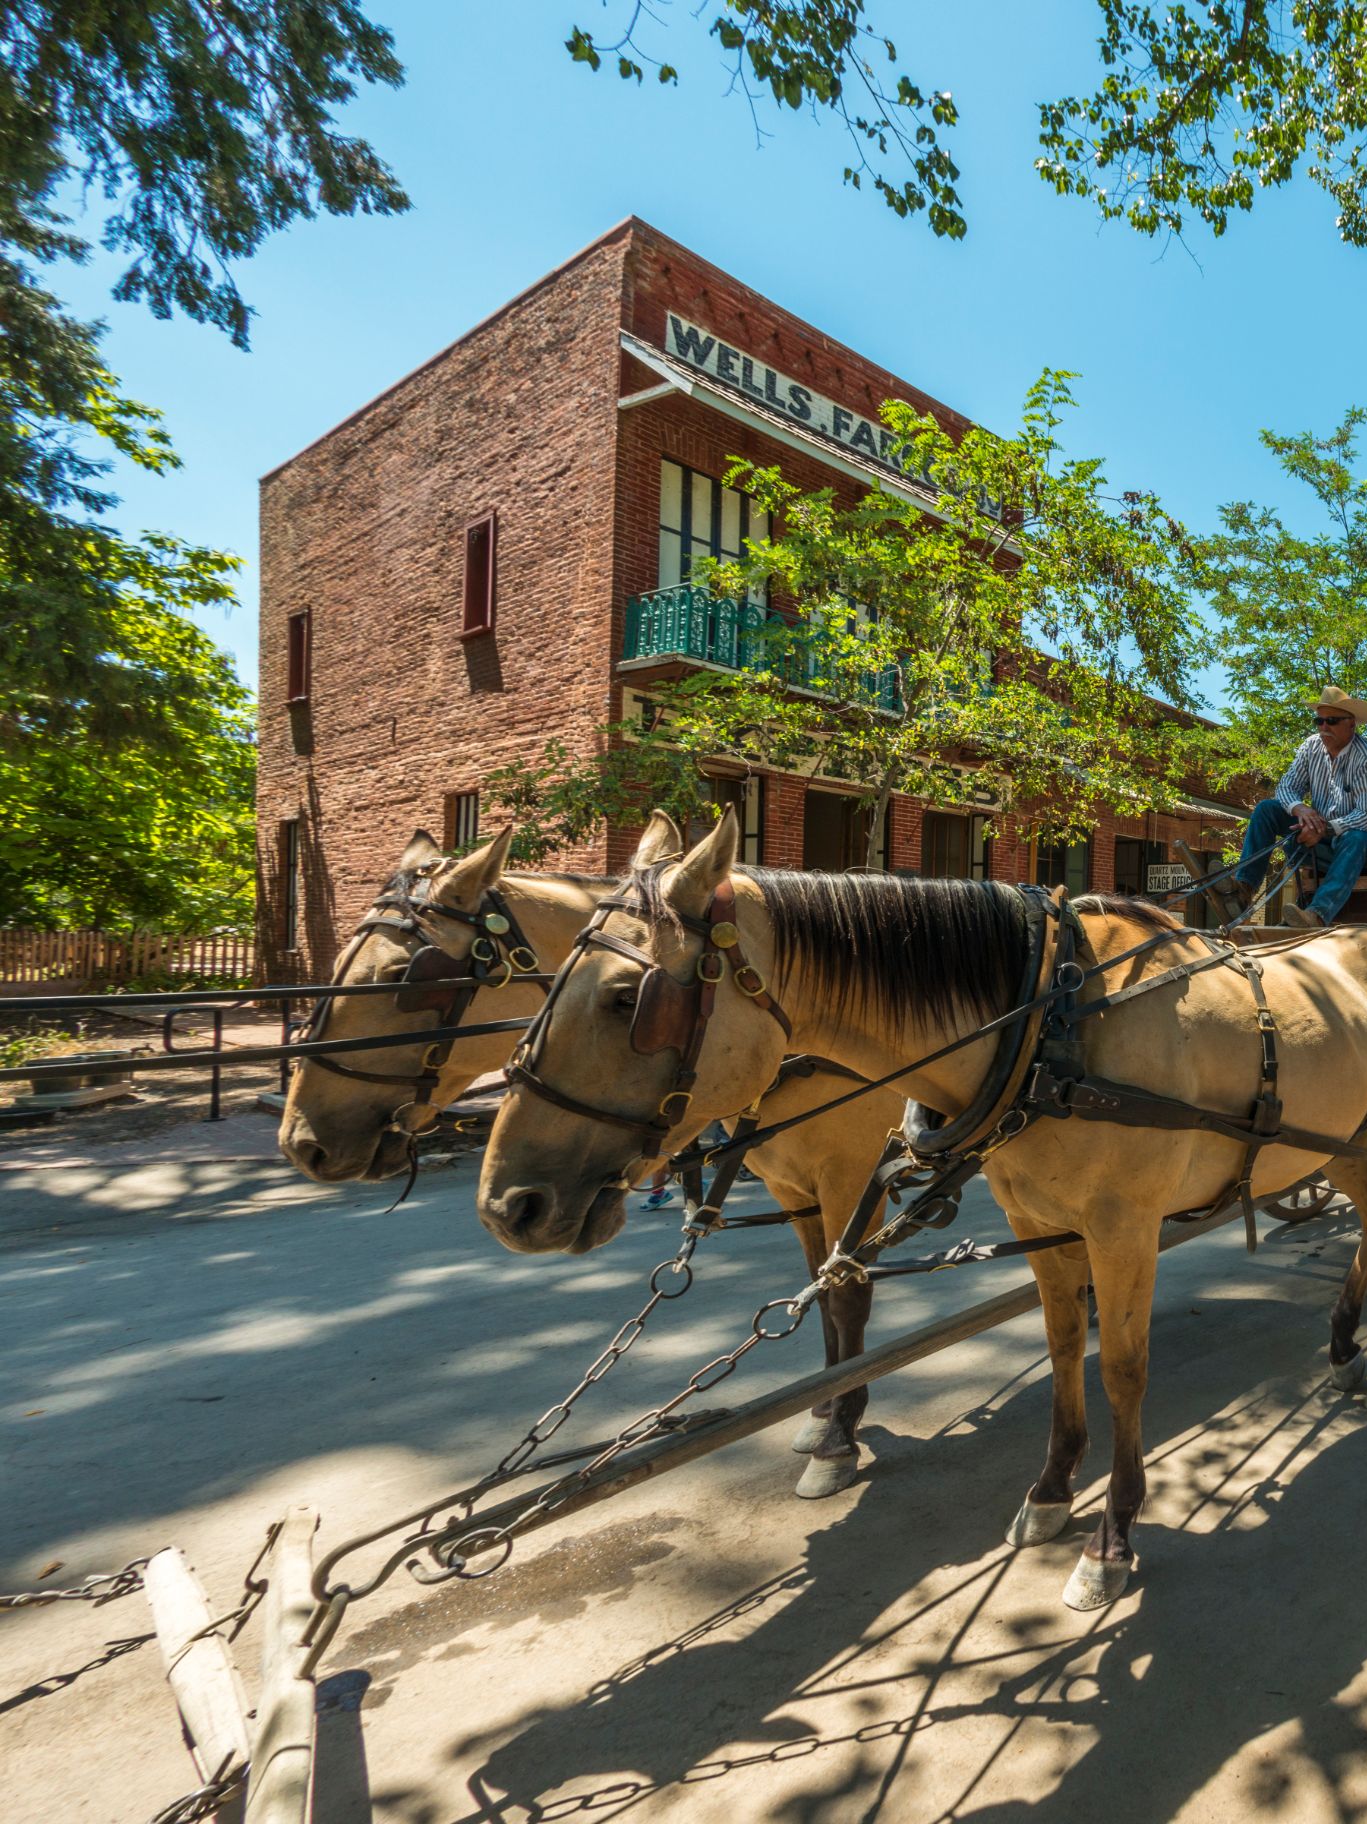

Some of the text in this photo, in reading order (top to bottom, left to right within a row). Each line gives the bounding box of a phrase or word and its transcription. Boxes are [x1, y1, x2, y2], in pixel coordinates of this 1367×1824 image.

[1150, 866, 1189, 875] QUARTZ MOUN
[1149, 876, 1170, 889] STAGE
